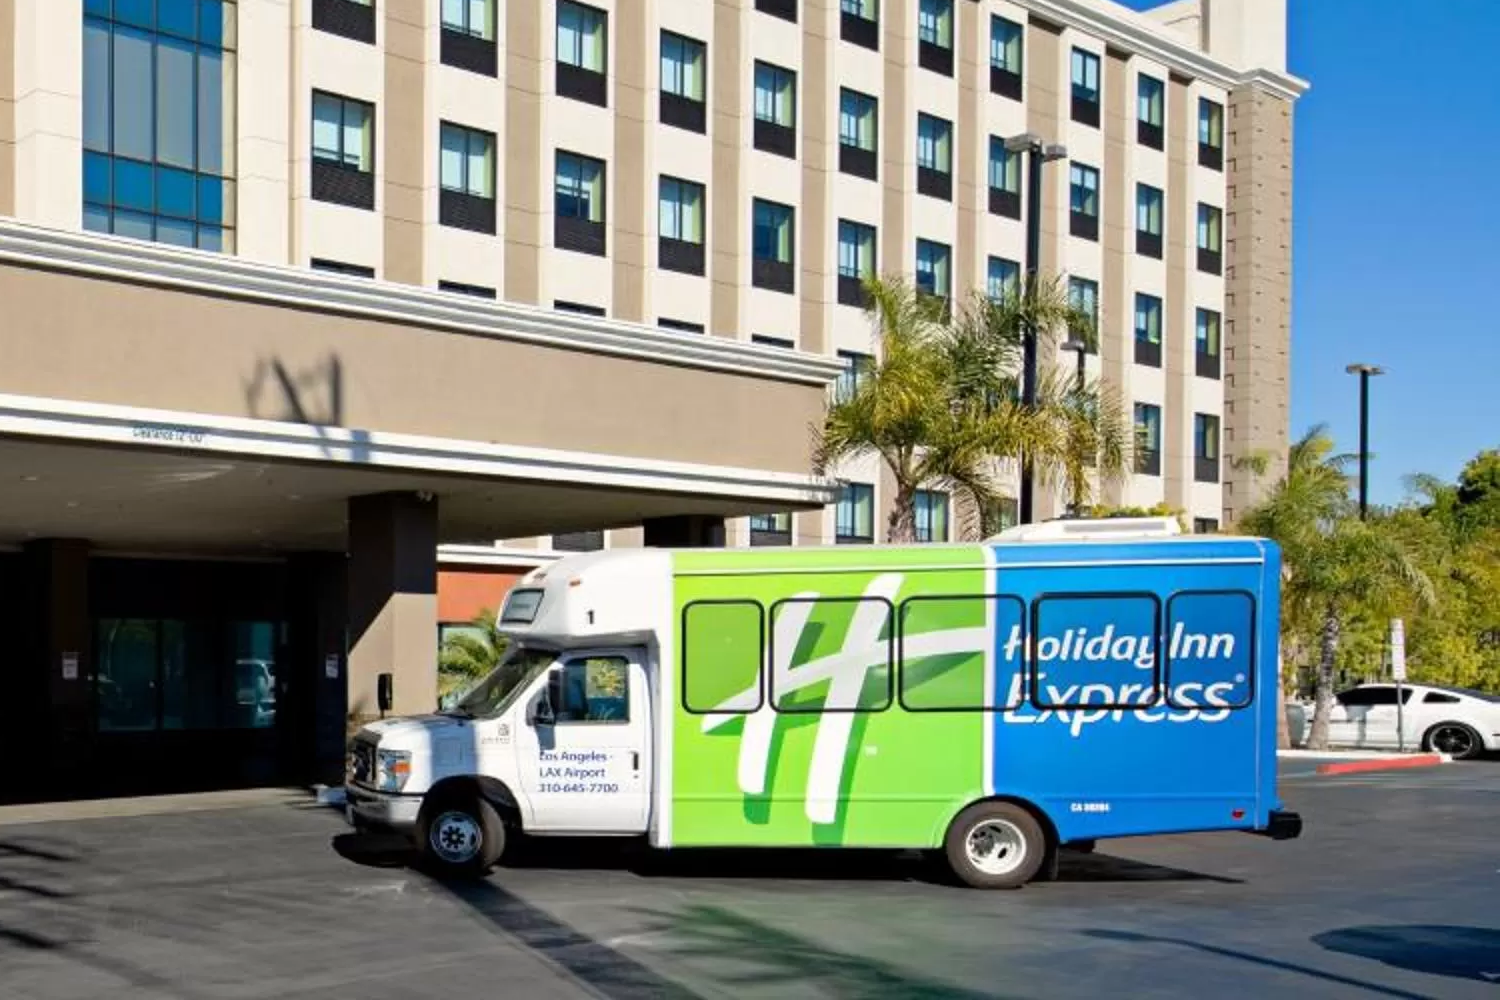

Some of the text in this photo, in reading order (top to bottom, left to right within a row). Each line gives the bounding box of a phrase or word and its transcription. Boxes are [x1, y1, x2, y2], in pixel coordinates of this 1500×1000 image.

[587, 609, 595, 625] 1
[1004, 621, 1235, 669] Holiday Inn
[1003, 673, 1233, 737] Express
[539, 751, 558, 761] Los
[560, 750, 607, 764] Angeles
[539, 767, 606, 781] LAX Airport
[538, 783, 619, 793] 310-645-7700
